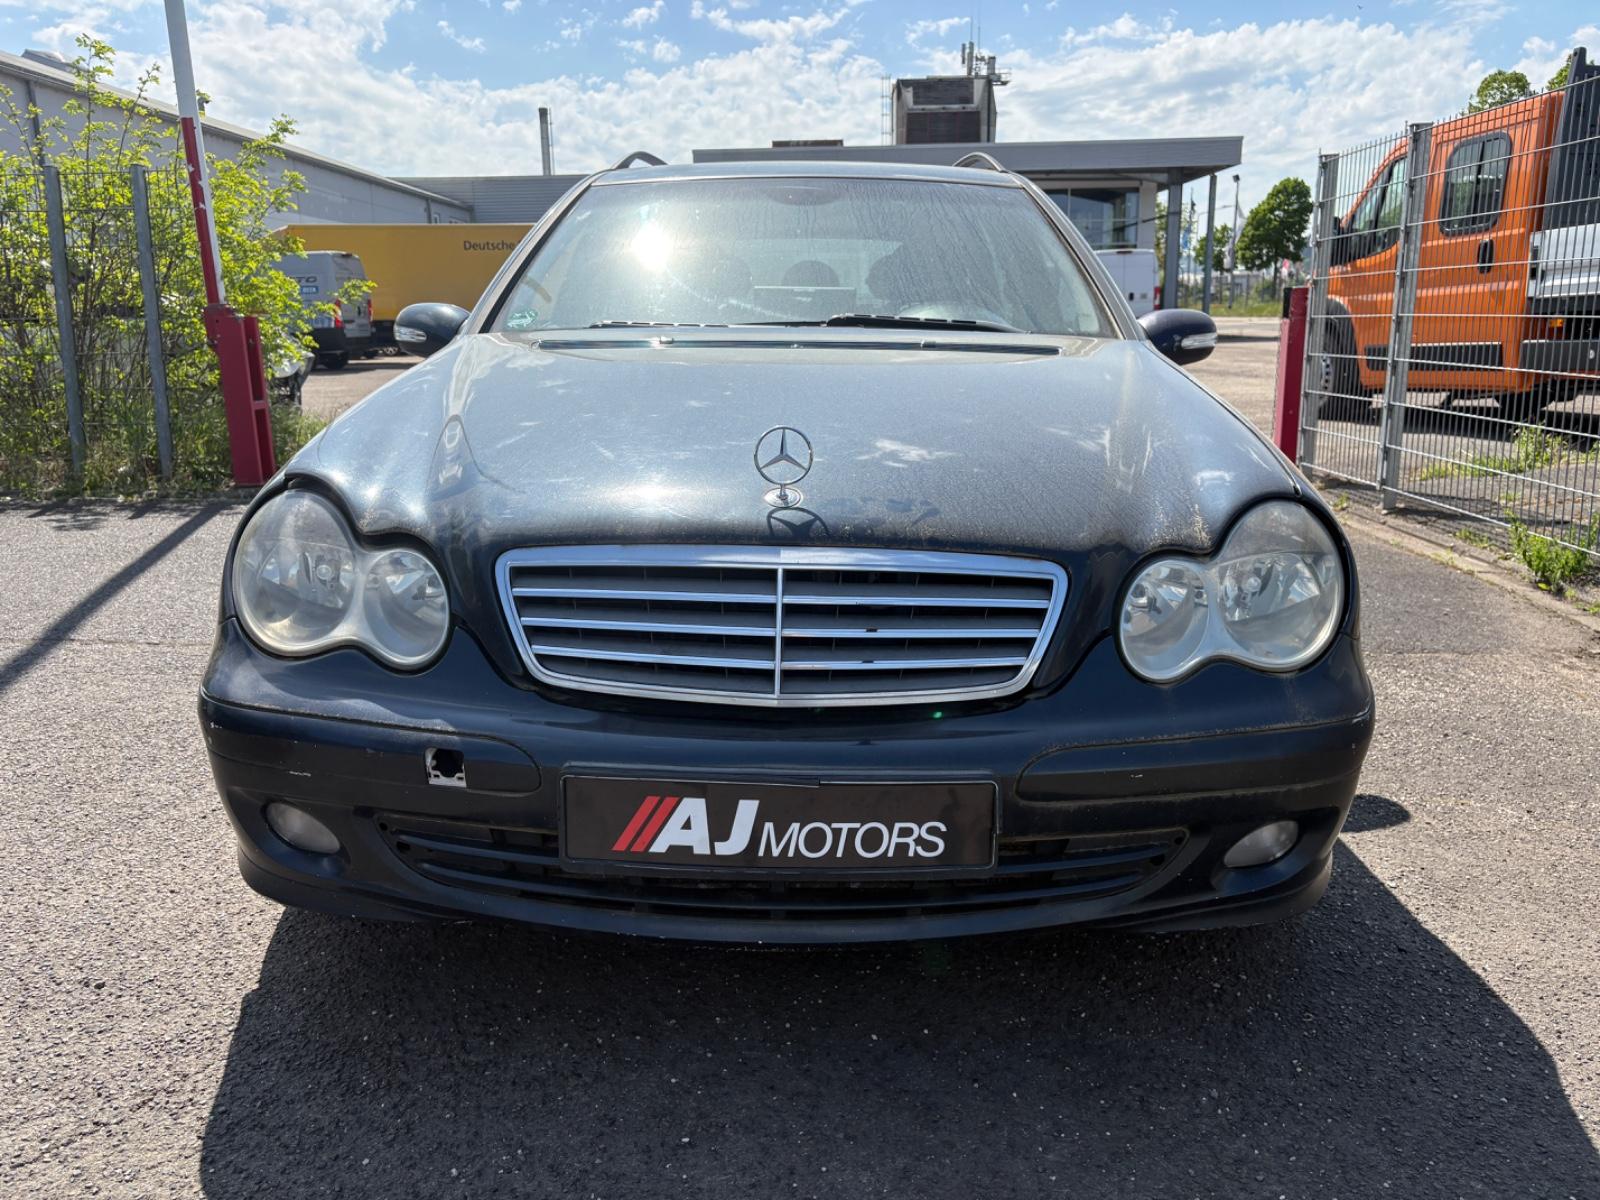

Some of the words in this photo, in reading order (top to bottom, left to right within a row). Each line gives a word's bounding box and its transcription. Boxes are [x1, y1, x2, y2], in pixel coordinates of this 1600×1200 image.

[463, 240, 515, 251] Deutsche
[648, 796, 760, 856] AJ
[758, 821, 947, 859] MOTORS
